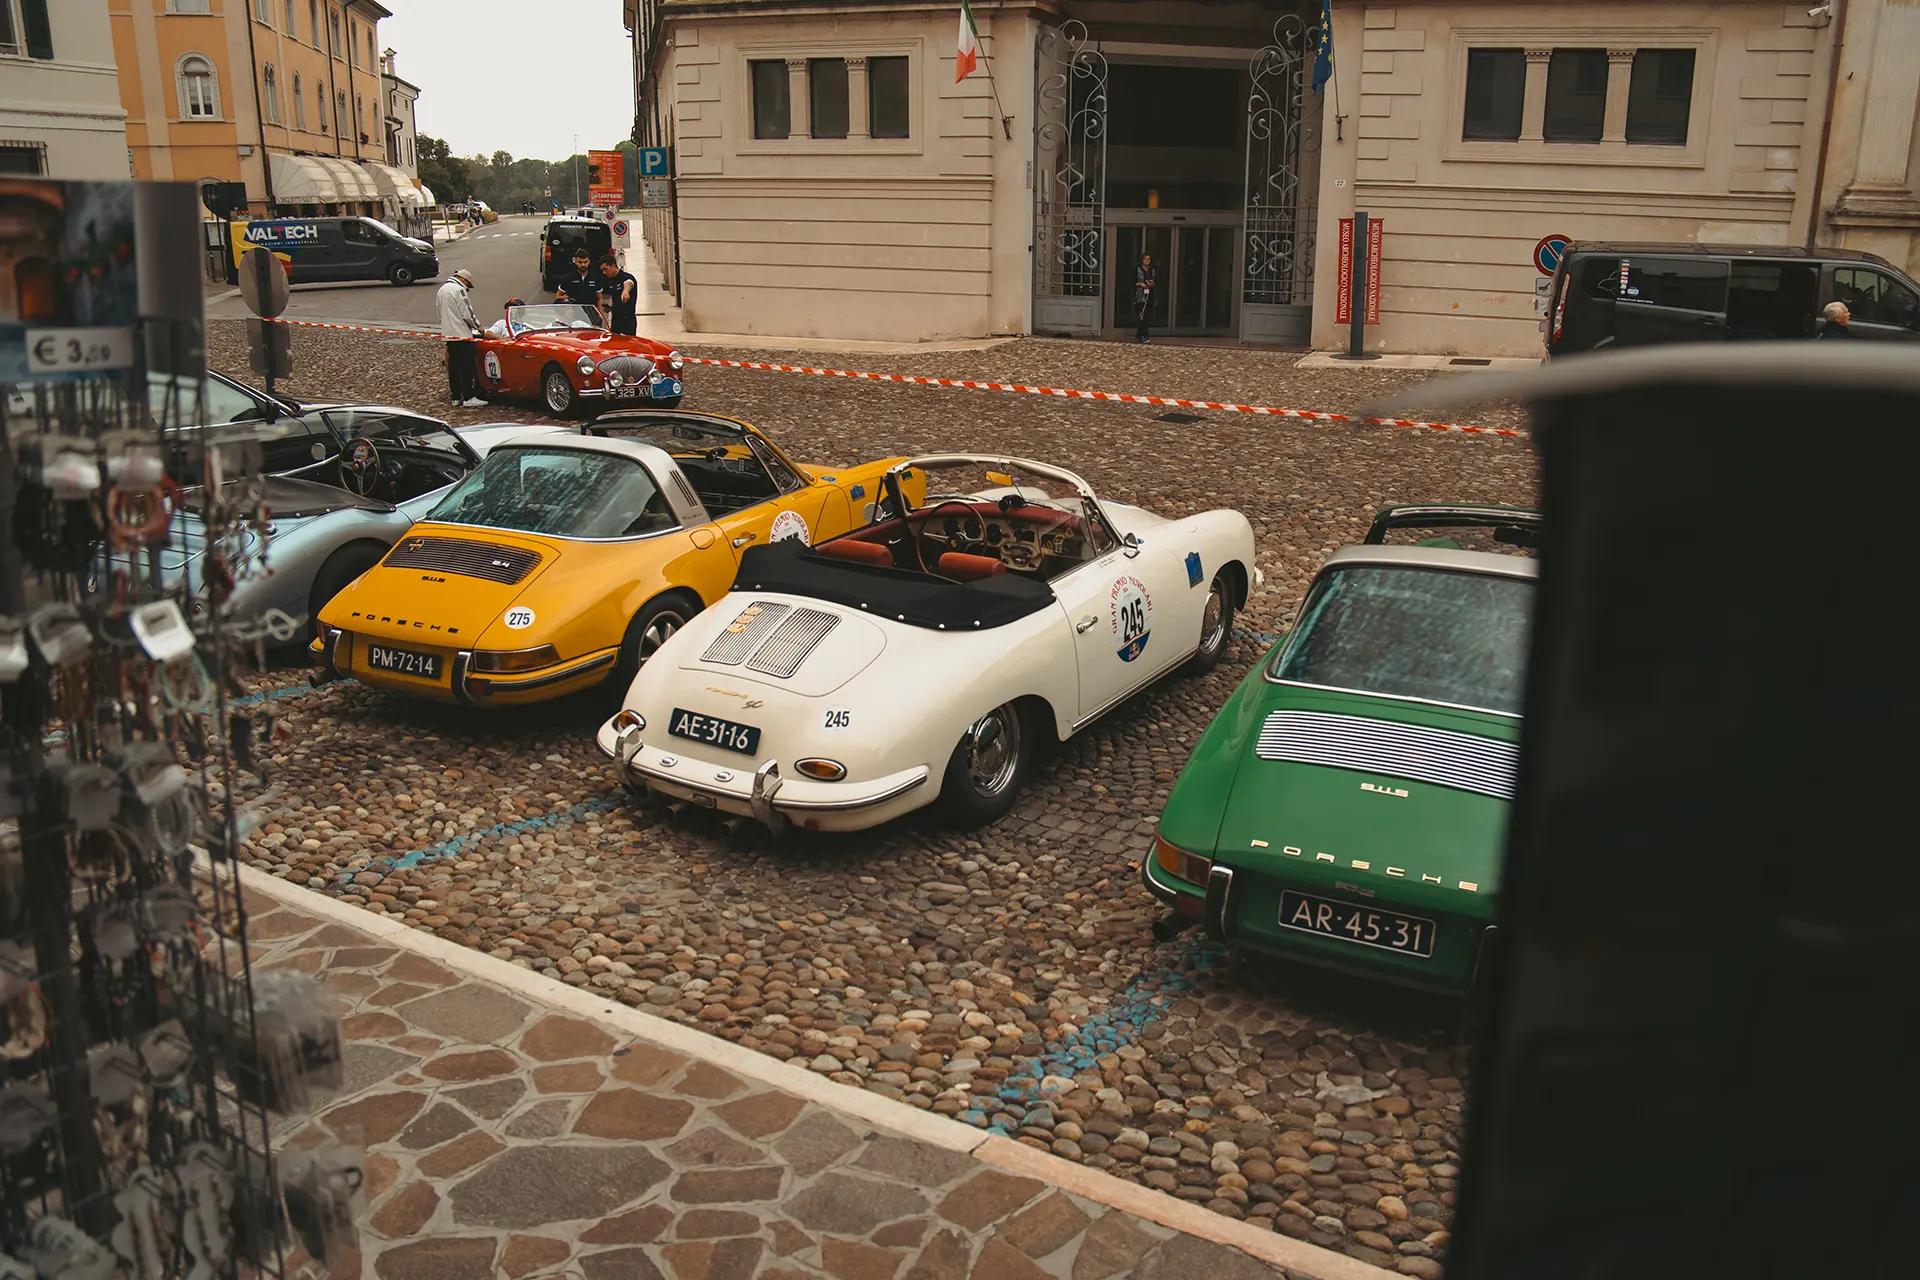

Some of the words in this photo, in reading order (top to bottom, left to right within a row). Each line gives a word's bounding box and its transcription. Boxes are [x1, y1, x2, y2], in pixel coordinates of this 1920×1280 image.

[645, 151, 662, 173] P
[245, 225, 318, 241] VALTECH
[1342, 222, 1350, 242] MUSEO
[1371, 222, 1380, 243] MUSEO
[1340, 243, 1350, 287] ARCHEOLOGICO
[1369, 244, 1379, 289] ARCHEOLOGICO
[1339, 288, 1348, 320] NAZIONALE
[1368, 289, 1377, 321] NAZIONALE
[33, 337, 58, 366] €
[617, 388, 635, 398] 329
[1111, 576, 1128, 600] PREMIO
[1128, 575, 1153, 612] NUVOLARI
[351, 612, 460, 634] PORSCHE
[509, 612, 530, 625] 275
[1110, 602, 1118, 634] GRAN
[1121, 597, 1144, 643] 245
[825, 710, 850, 728] 245
[1250, 839, 1478, 892] PORSCHE
